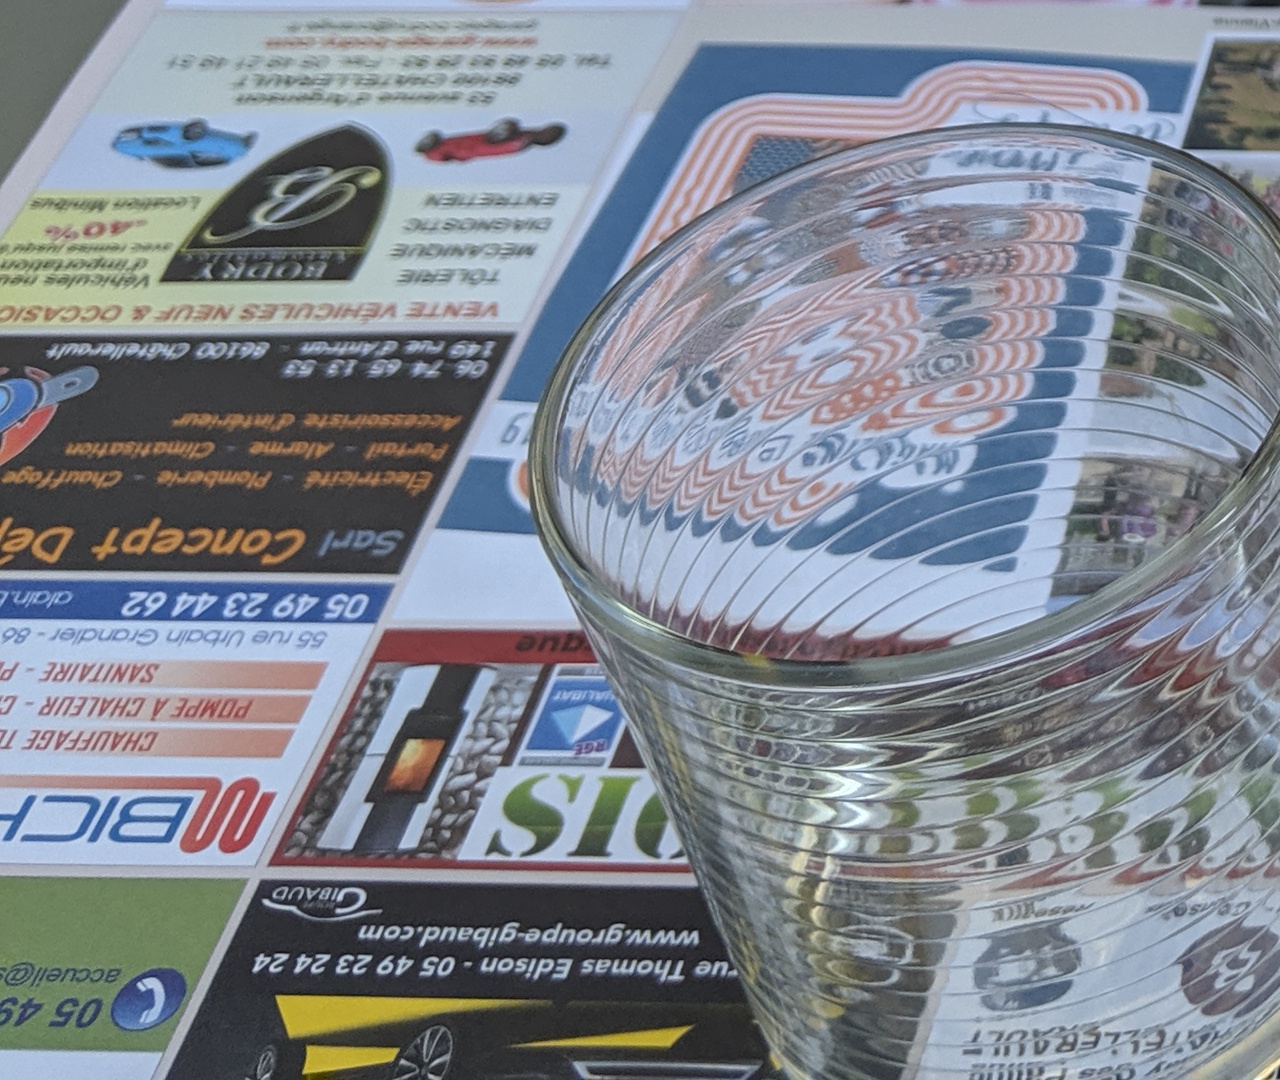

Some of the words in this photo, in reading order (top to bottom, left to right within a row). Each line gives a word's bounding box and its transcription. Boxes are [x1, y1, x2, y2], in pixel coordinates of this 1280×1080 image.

[424, 192, 560, 209] ENTRETIEN
[402, 216, 554, 234] DIAGNOSTIC
[390, 241, 538, 263] MÉCANIQUE
[395, 266, 502, 289] TÔLERIE
[130, 304, 153, 322] &
[153, 302, 235, 322] NEUF
[240, 301, 400, 324] VÉHICULES
[405, 300, 500, 320] VENTE
[45, 340, 191, 361] Châtellerault
[299, 339, 401, 357] d'Antran
[405, 339, 445, 354] rue
[170, 412, 296, 433] d'intérieur
[304, 412, 463, 431] Accessoiriste
[64, 440, 216, 460] Climatisation
[248, 440, 336, 458] Alarme
[365, 440, 449, 459] Portail
[1, 465, 124, 490] Chauffage
[156, 469, 273, 489] Plomberie
[305, 470, 434, 496] Électricité
[90, 517, 307, 565] Concept
[318, 529, 404, 557] Sarl
[120, 591, 168, 617] 62
[170, 592, 218, 617] 44
[224, 592, 270, 618] 23
[273, 592, 320, 619] 49
[327, 592, 370, 619] 05
[48, 628, 158, 647] Grandier
[165, 629, 246, 647] Urbain
[252, 629, 291, 644] rue
[294, 630, 328, 648] 55
[39, 662, 160, 683] SANITAIRE
[38, 696, 146, 718] CHALEUR
[149, 697, 170, 721] À
[169, 697, 253, 719] POMPE
[22, 730, 159, 752] CHAUFFAGE
[357, 922, 700, 948] www.groupe-gibaud.com
[251, 951, 290, 973] 24
[294, 952, 332, 974] 24
[337, 953, 373, 974] 23
[379, 953, 415, 975] 49
[421, 954, 456, 976] 05
[479, 955, 573, 979] Edison
[577, 957, 686, 981] Thomas
[48, 998, 103, 1029] 05
